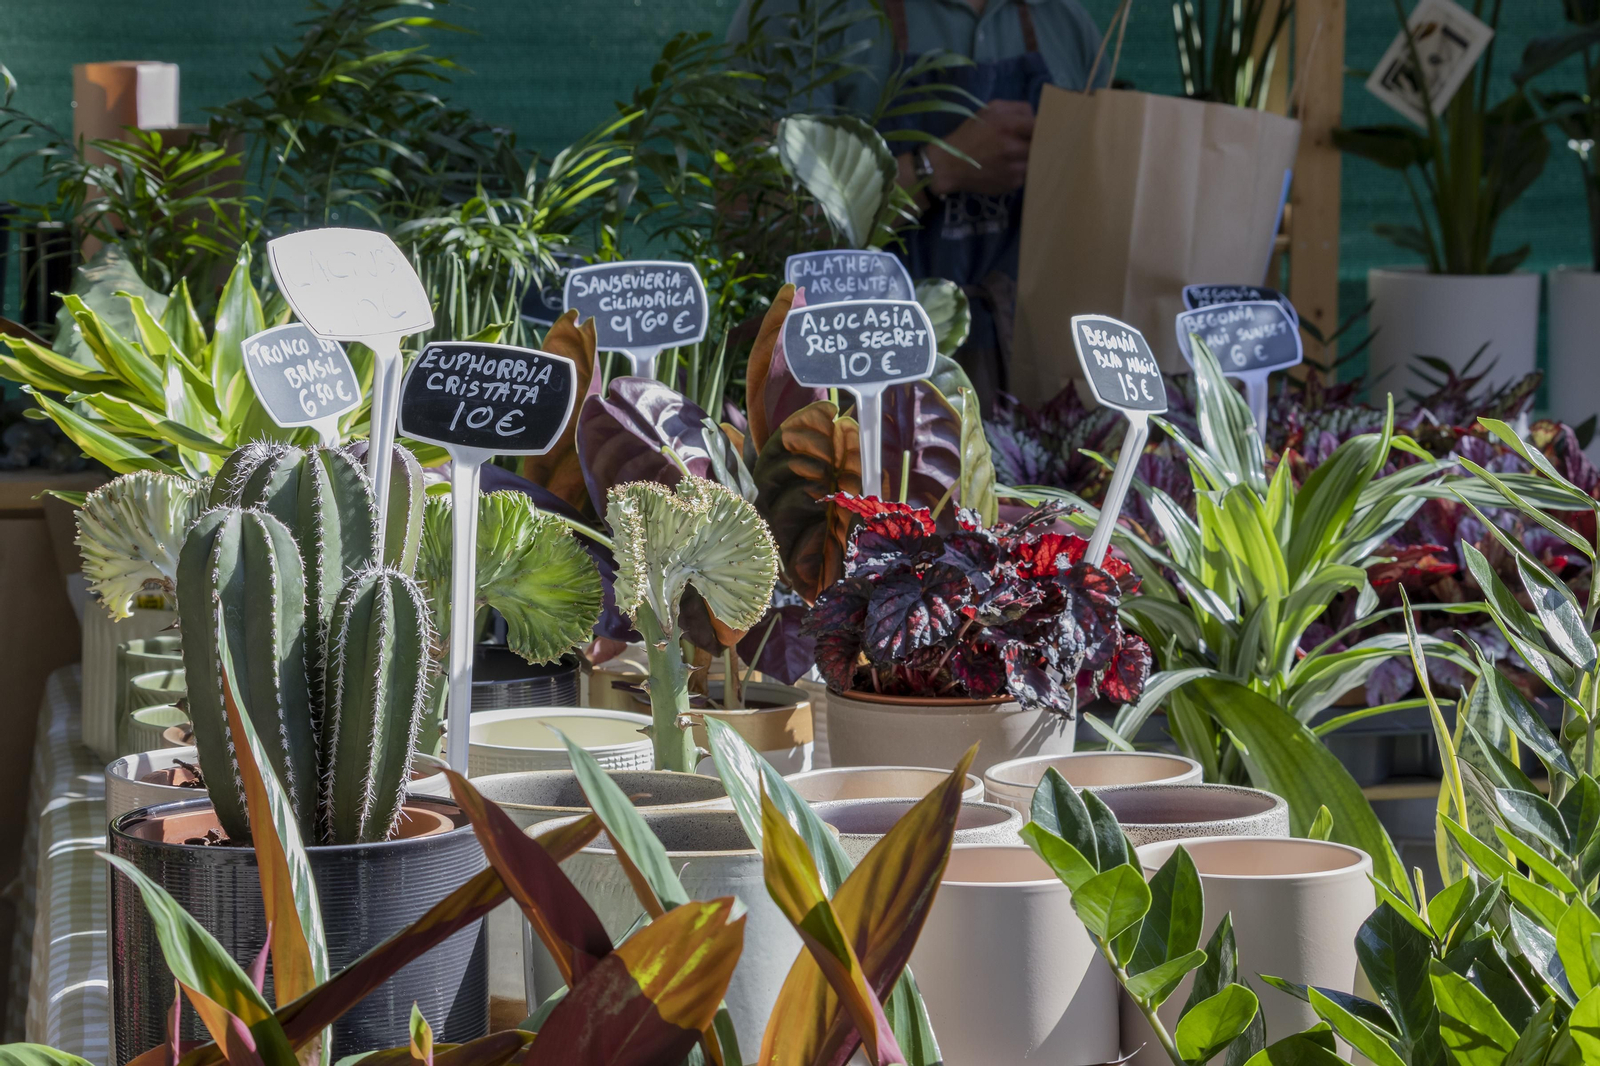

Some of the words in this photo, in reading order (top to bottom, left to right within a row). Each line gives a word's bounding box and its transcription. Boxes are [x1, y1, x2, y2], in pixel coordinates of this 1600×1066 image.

[791, 255, 885, 277] CALATHEA
[572, 270, 681, 297] SANSEVIERIA
[811, 275, 898, 294] ARGENTEA
[800, 306, 915, 337] ALOCASIA
[1183, 305, 1255, 333] BEGONIA
[248, 338, 309, 367] TRONCO
[806, 334, 848, 356] RED
[859, 328, 927, 349] SECRET
[1081, 325, 1139, 353] BEGONIA
[283, 356, 342, 389] BRASIL
[419, 348, 553, 385] EUPHORBIA
[426, 372, 540, 405] CRISTATA
